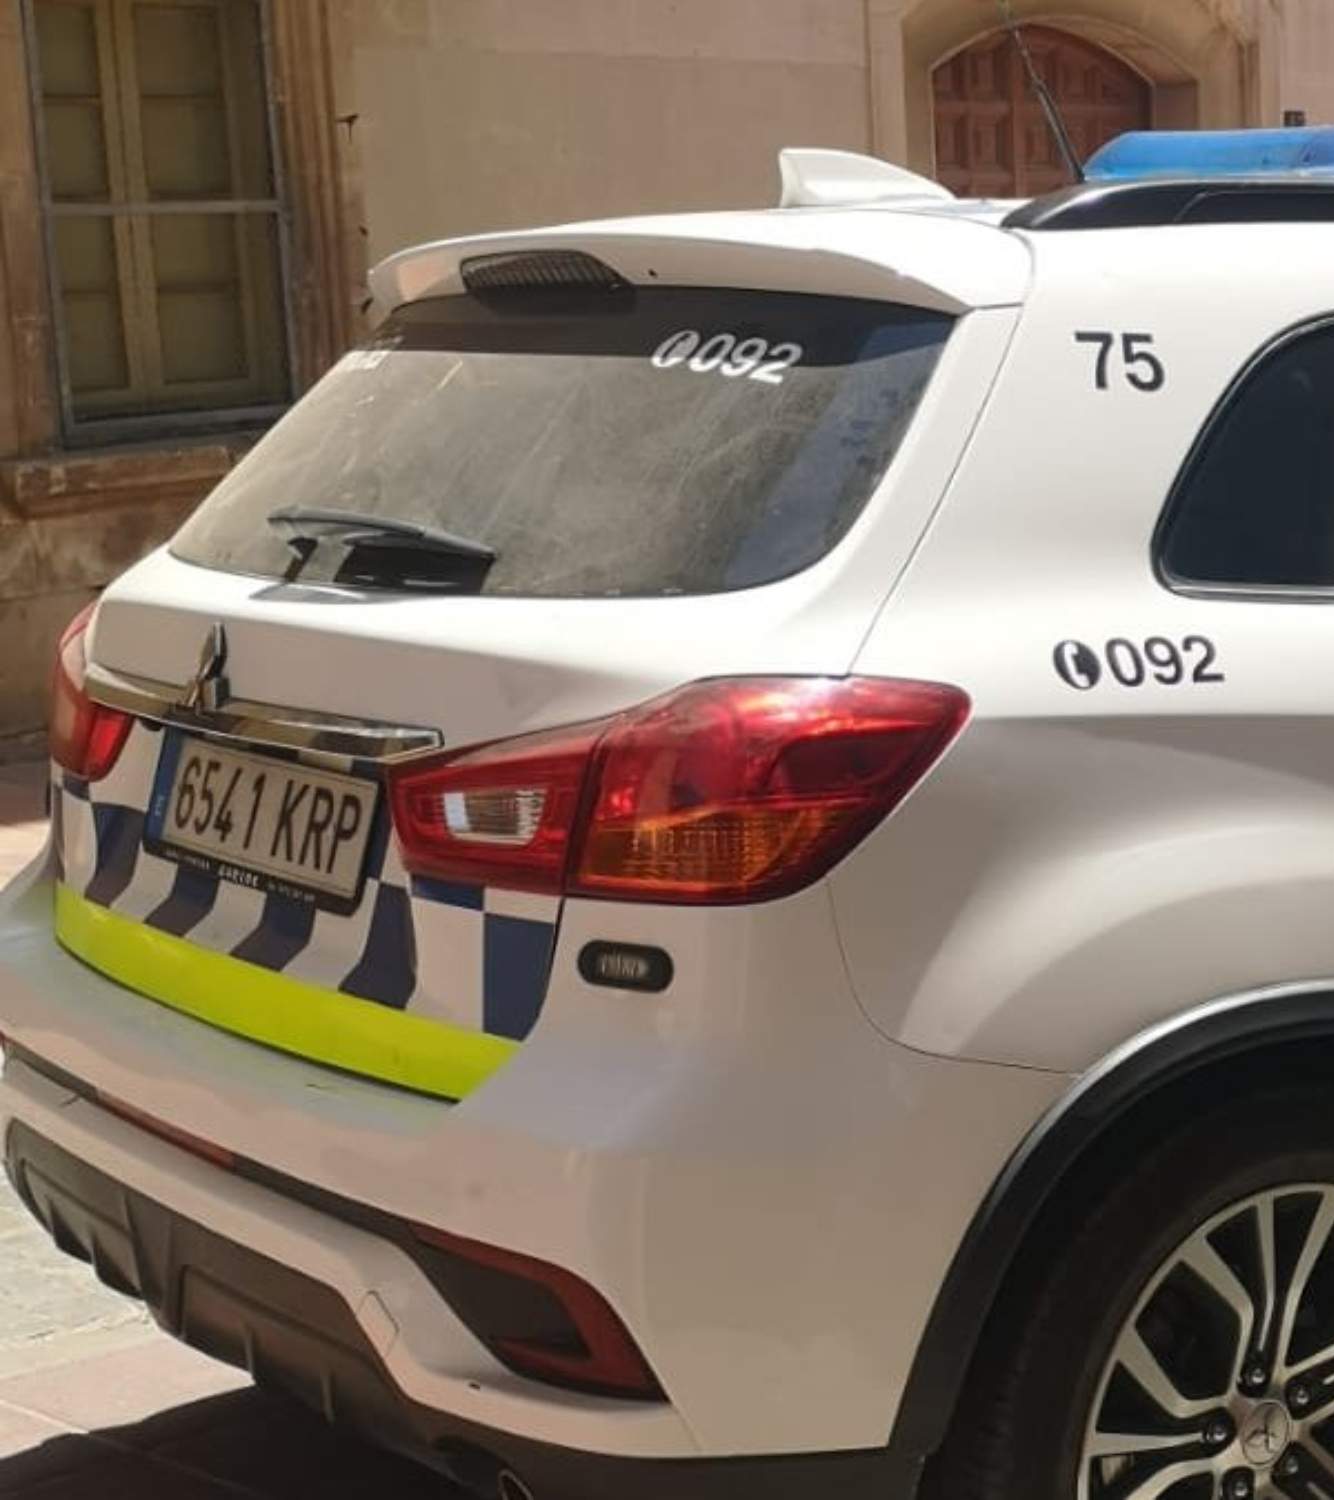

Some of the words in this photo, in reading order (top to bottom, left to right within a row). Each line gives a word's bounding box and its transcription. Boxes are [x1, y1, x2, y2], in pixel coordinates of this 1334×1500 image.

[688, 332, 804, 385] 092
[1074, 331, 1166, 392] 75
[1104, 635, 1225, 688] 092
[174, 755, 267, 850] 6541
[269, 778, 362, 875] KRP
